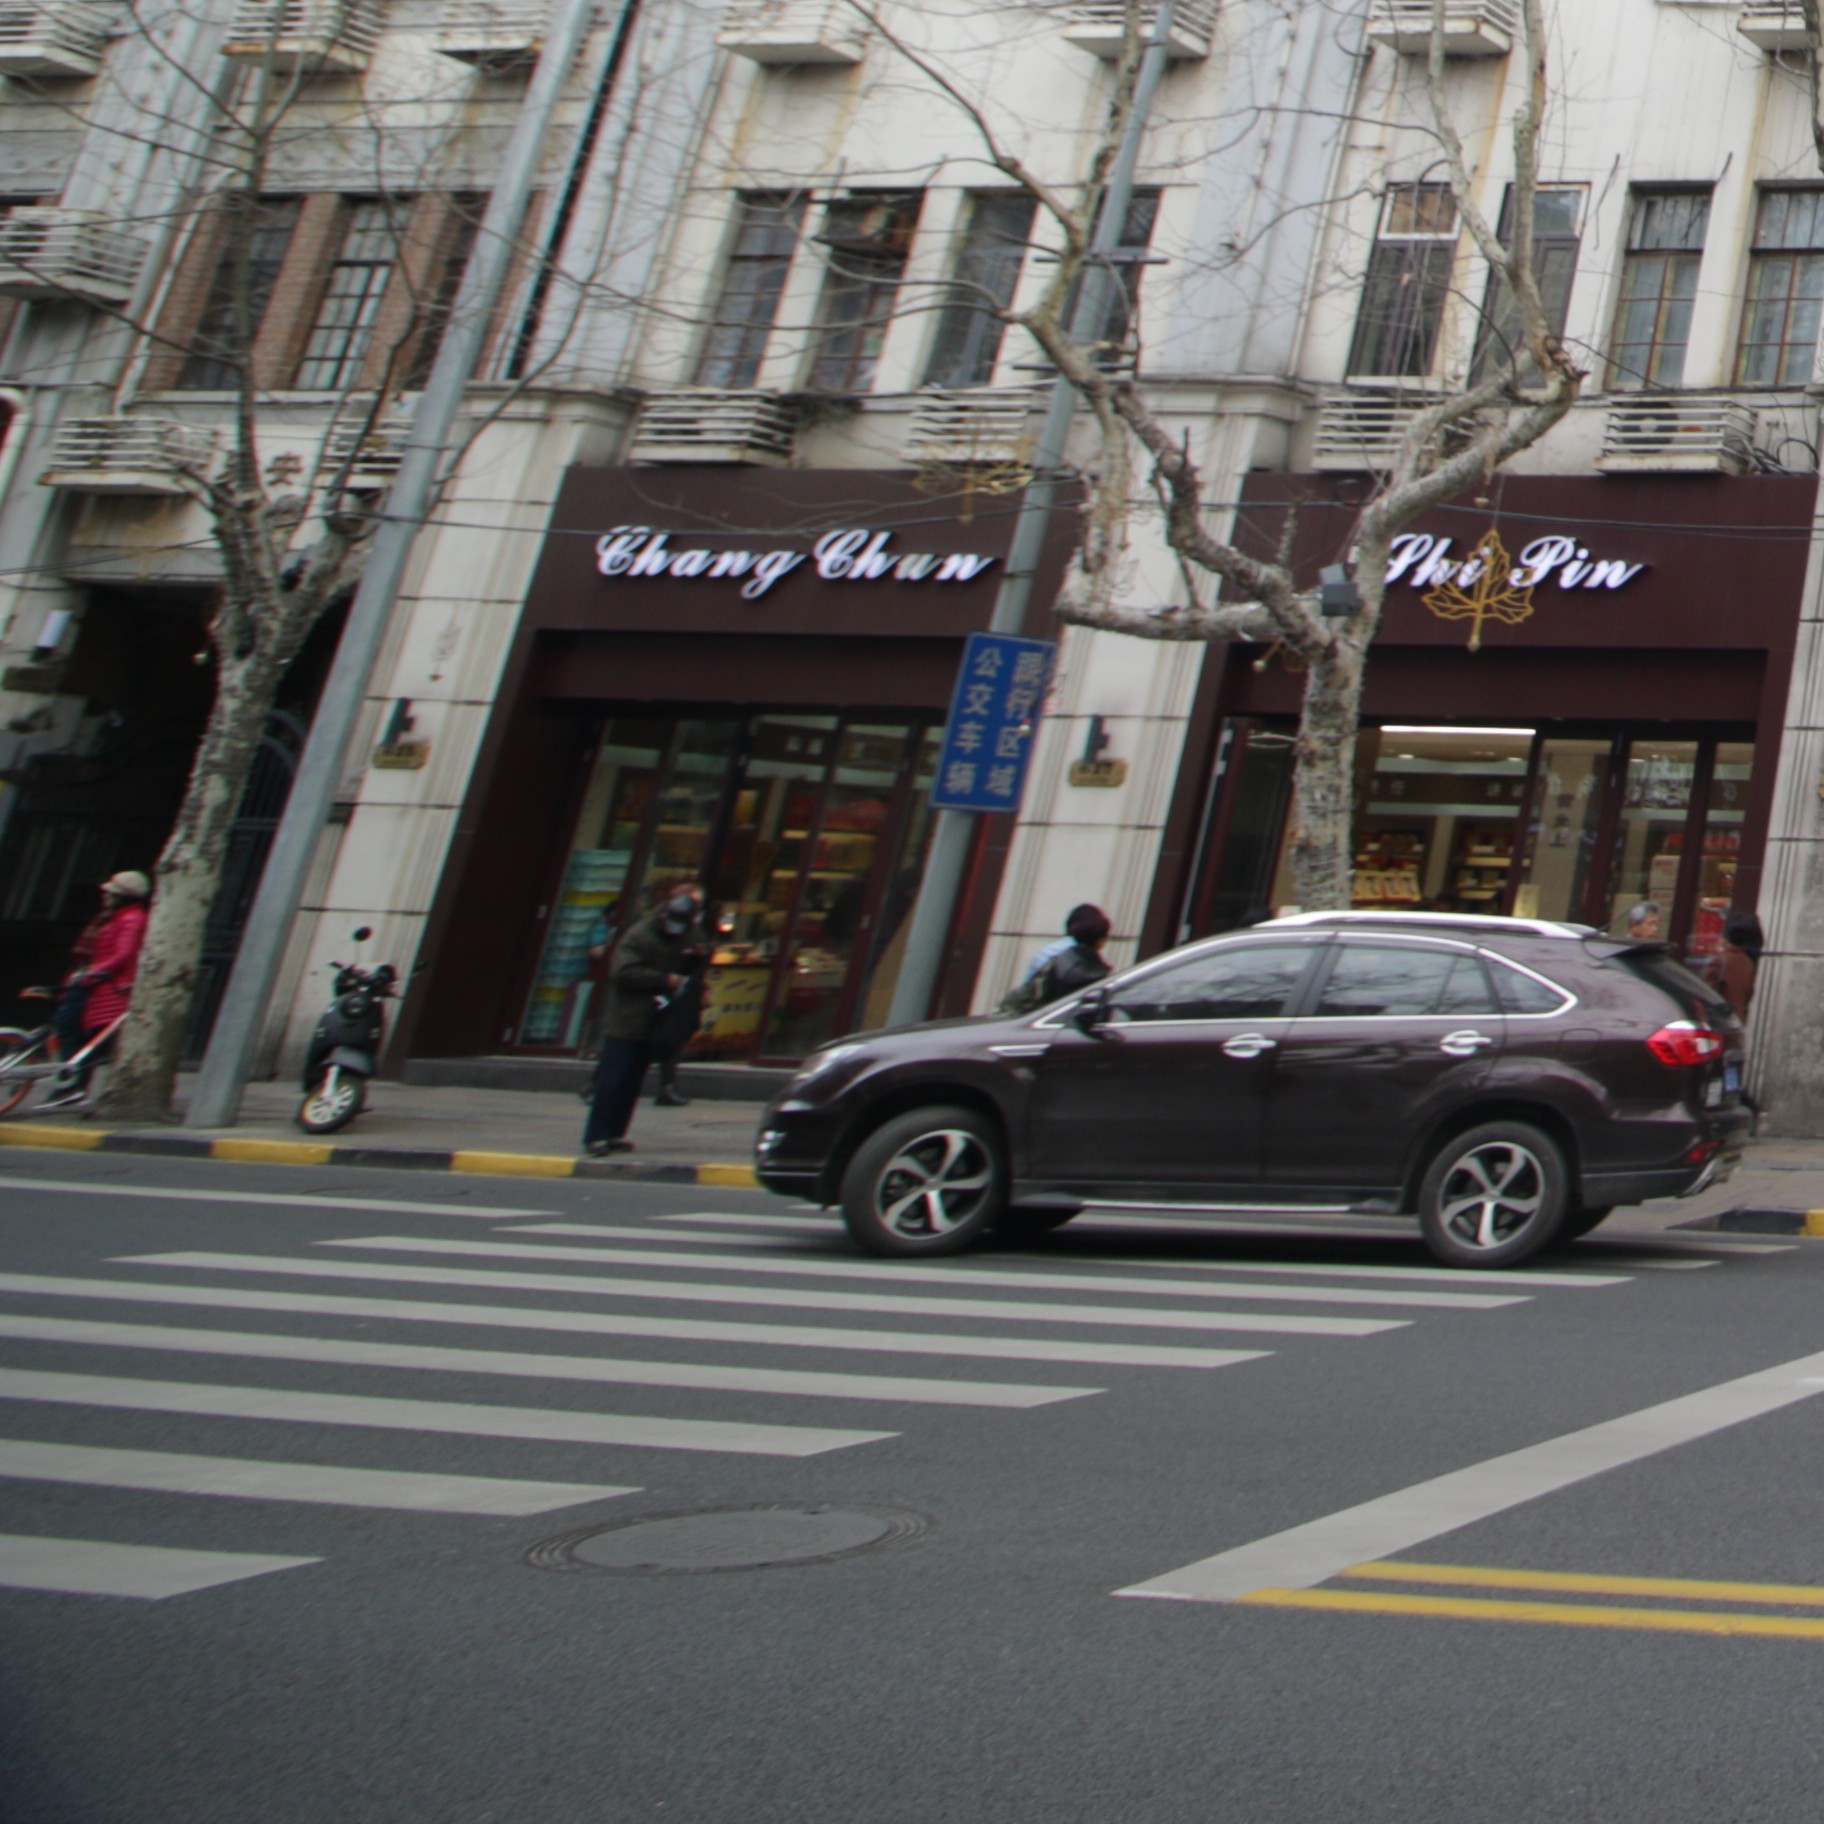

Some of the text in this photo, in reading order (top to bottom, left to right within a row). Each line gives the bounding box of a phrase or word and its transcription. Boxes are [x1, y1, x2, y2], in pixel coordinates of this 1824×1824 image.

[596, 525, 993, 600] Chang Chun
[1508, 535, 1644, 589] Pin
